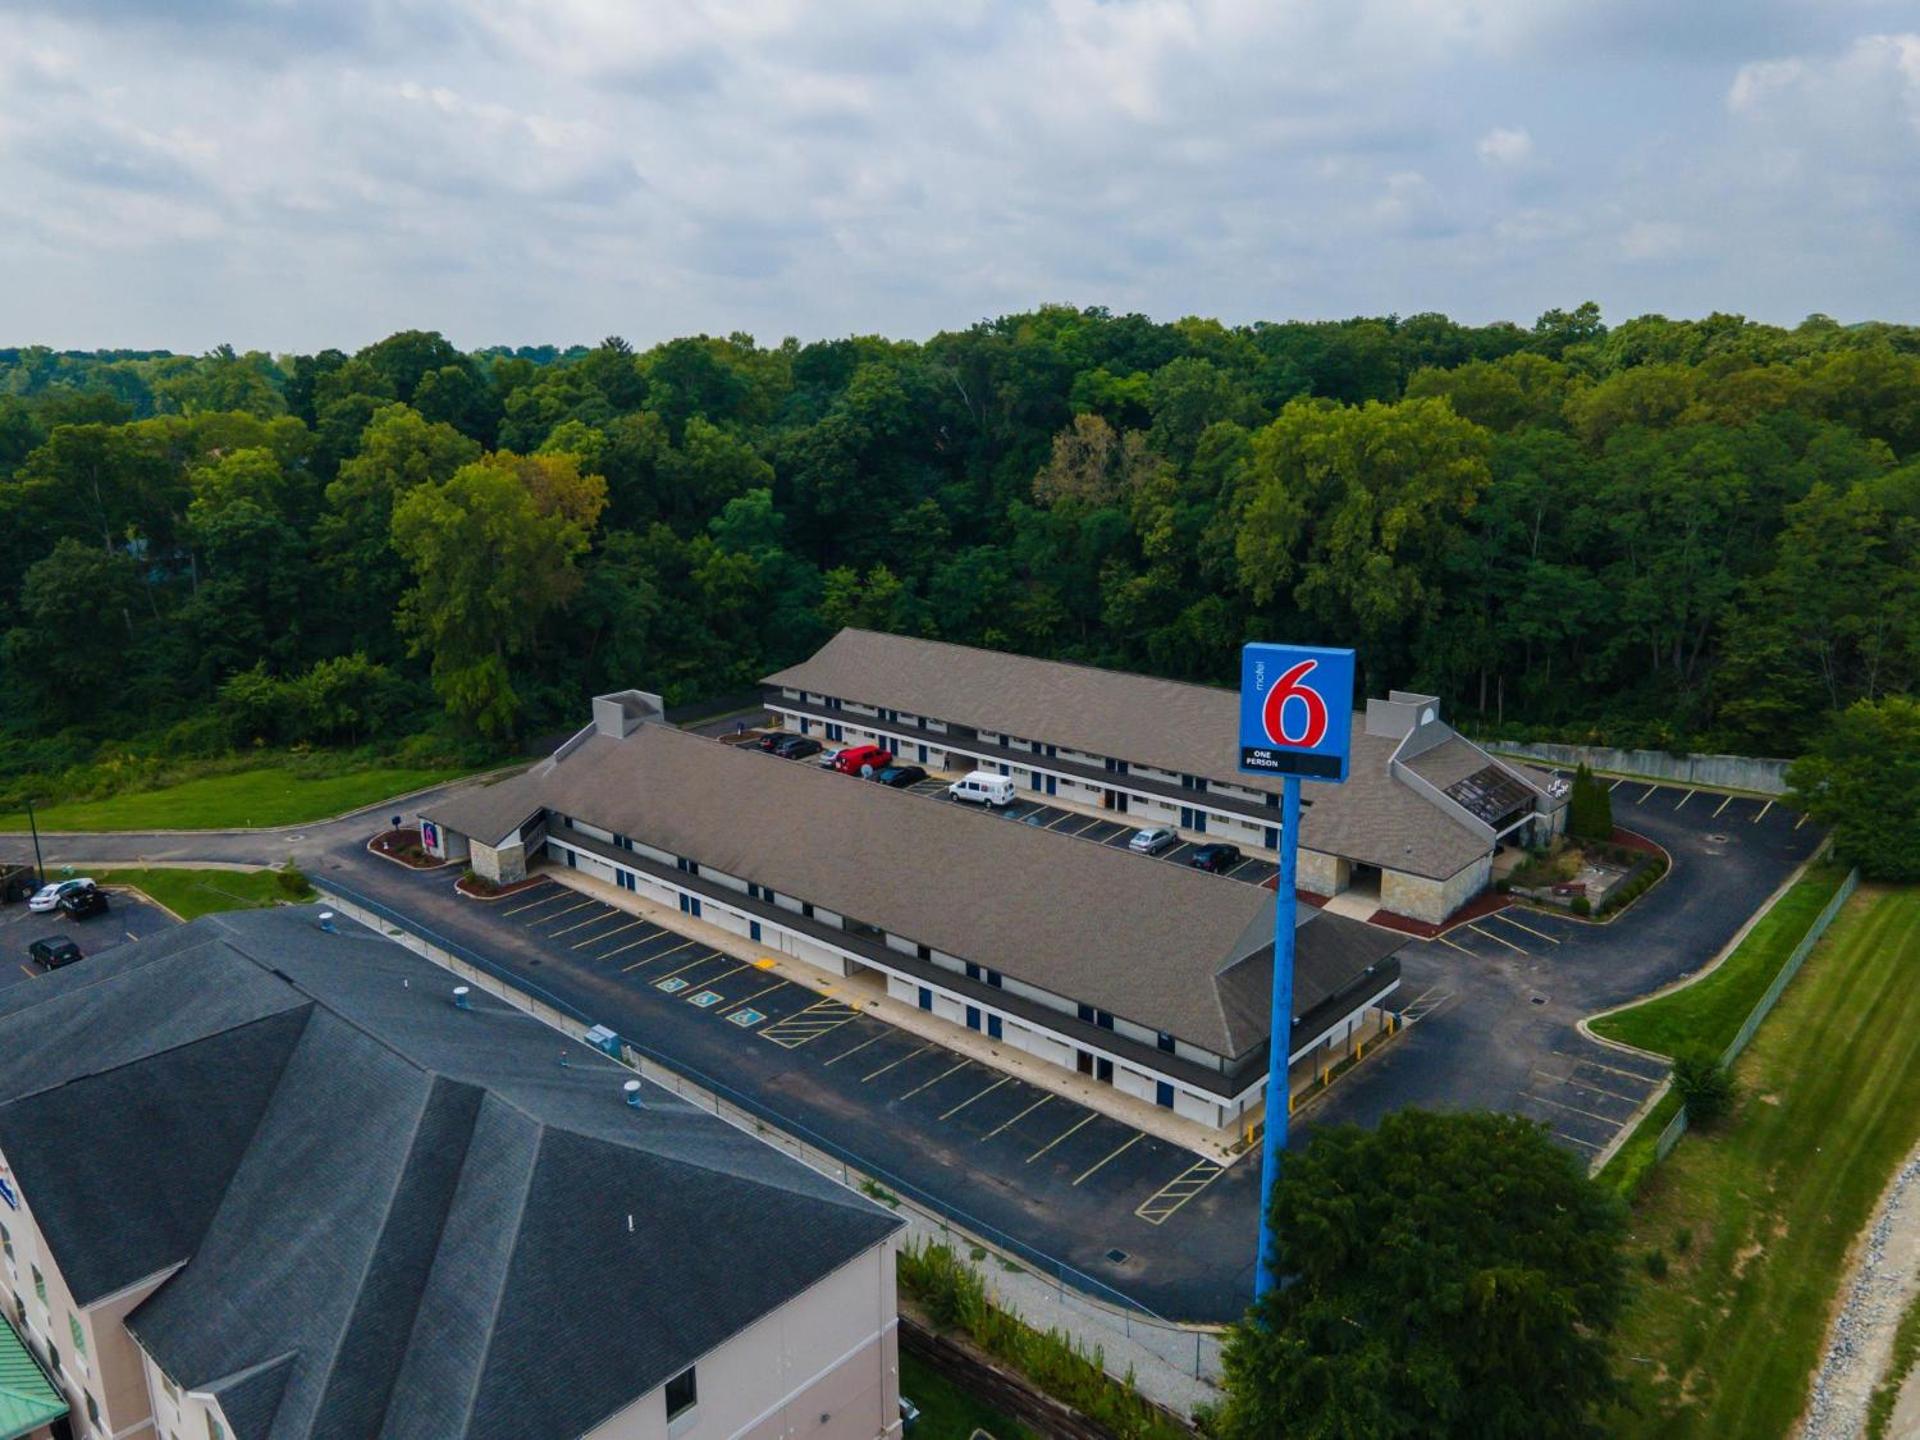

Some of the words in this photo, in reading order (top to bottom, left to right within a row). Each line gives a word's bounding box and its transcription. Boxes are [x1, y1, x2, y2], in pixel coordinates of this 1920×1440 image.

[1255, 661, 1265, 691] motel
[1262, 659, 1328, 748] 6
[1246, 757, 1279, 768] PERSON
[1253, 750, 1271, 759] ONE
